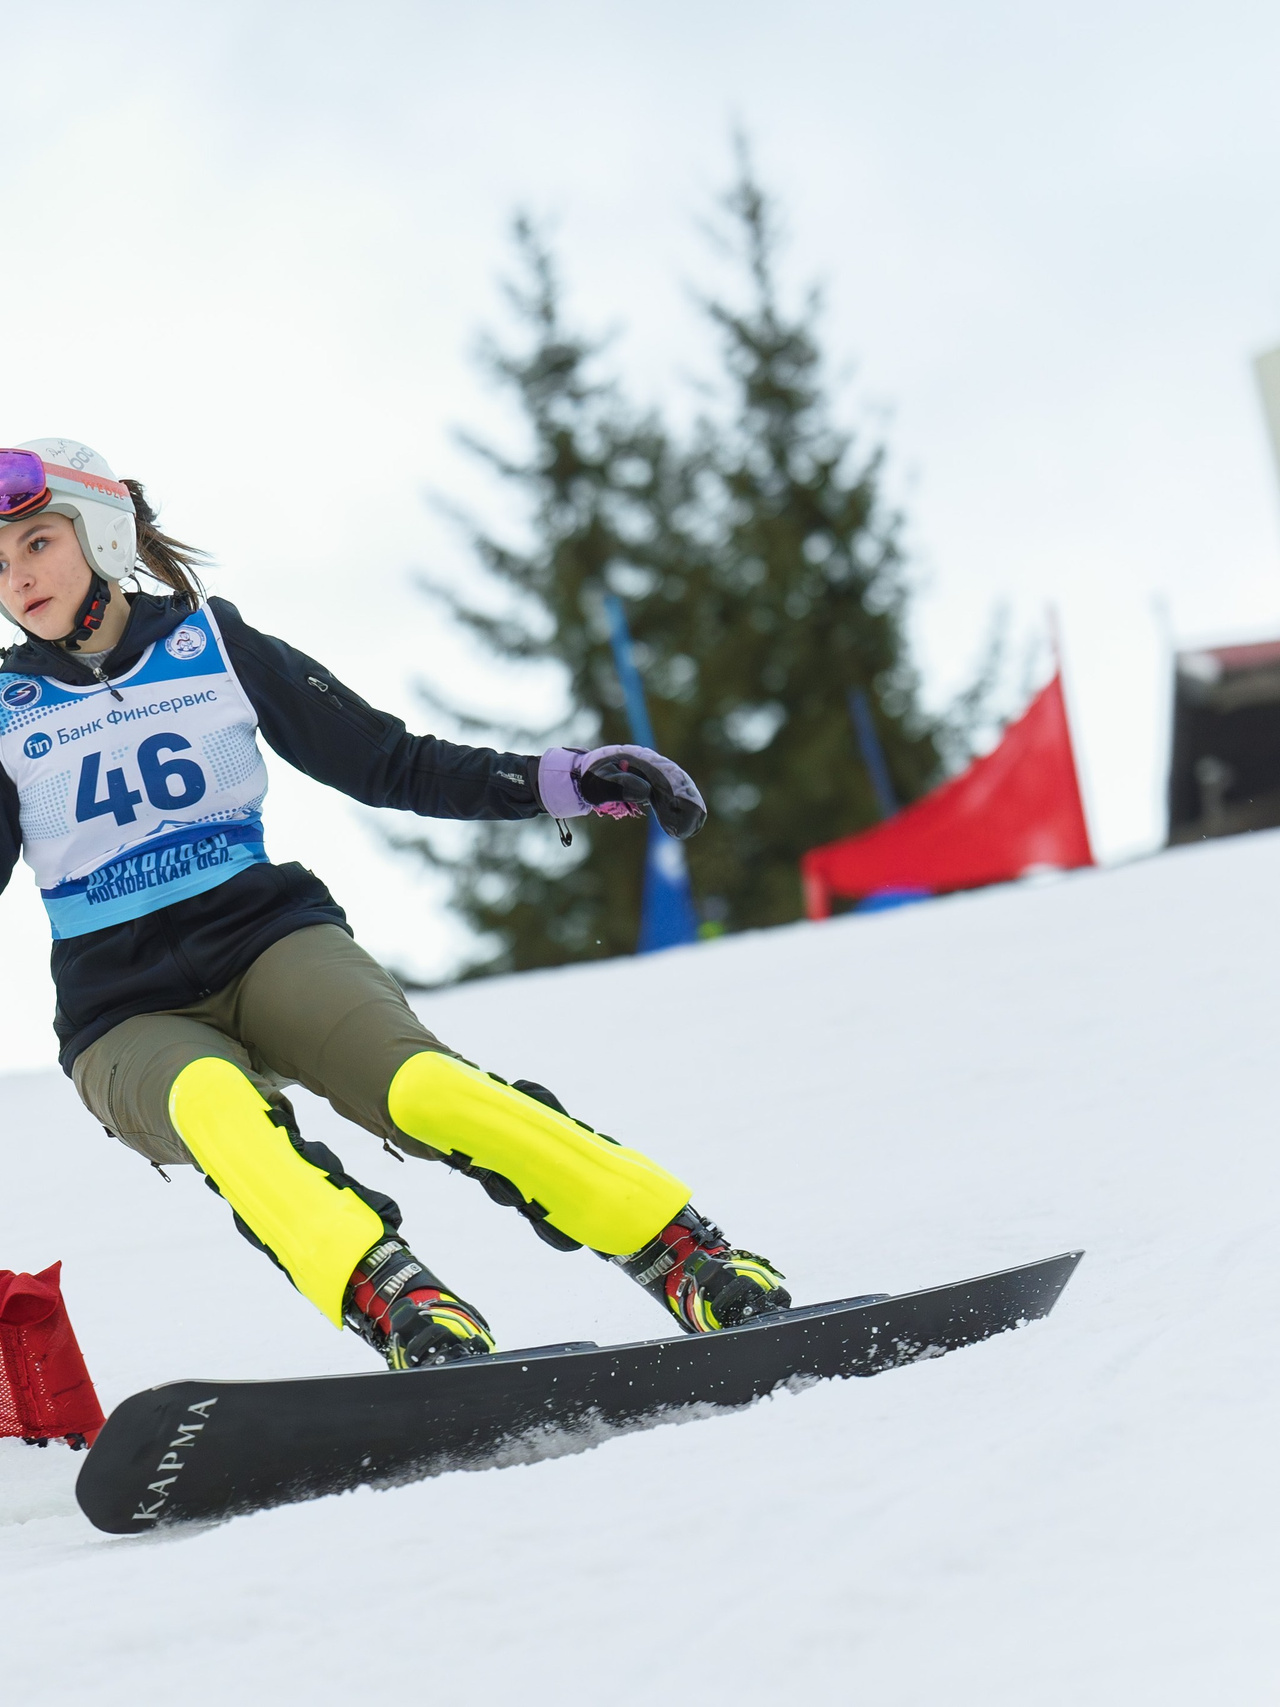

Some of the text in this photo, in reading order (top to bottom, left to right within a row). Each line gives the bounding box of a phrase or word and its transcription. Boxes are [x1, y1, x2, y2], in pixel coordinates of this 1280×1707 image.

[56, 690, 218, 745] Банк Финсервис
[26, 738, 50, 756] fin
[75, 732, 207, 827] 46
[86, 860, 191, 905] МОСКОВСКАЯ
